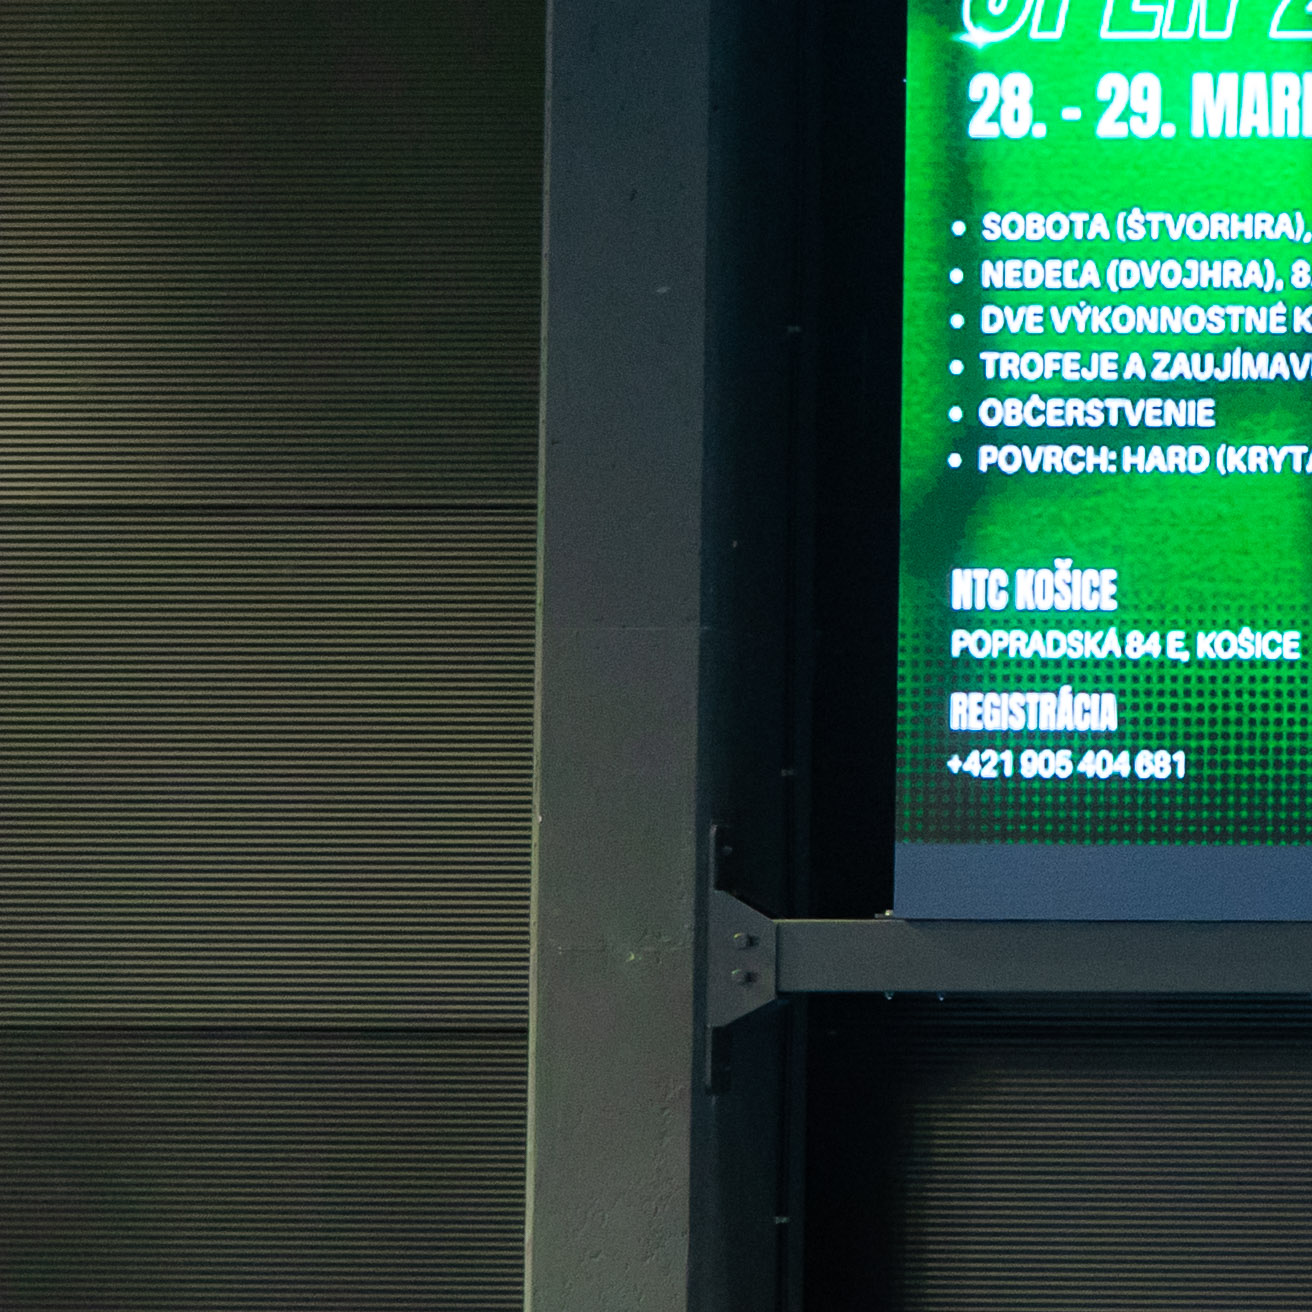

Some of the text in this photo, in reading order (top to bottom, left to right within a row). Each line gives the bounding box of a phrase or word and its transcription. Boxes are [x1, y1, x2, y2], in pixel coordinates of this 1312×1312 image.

[968, 72, 1047, 139] 28.
[1096, 72, 1176, 139] 29.
[982, 211, 1111, 241] SOBOTA
[1116, 206, 1312, 244] (ŠTVORHRA),
[1106, 258, 1284, 293] (DVOJHRA),
[981, 305, 1044, 334] DVE
[1050, 300, 1287, 335] VÝKONNOSTNÉ
[979, 350, 1119, 382] TROFEJE
[1123, 351, 1146, 380] A
[978, 394, 1216, 428] OBČERSTVENIE
[979, 444, 1117, 475] POVRCH:
[1122, 444, 1210, 474] HARD
[951, 557, 1118, 612] NTC KOŠICE
[951, 626, 1301, 662] POPRADSKÁ 84 E, KOŠICE
[949, 684, 1118, 732] REGISTRÁCIA
[946, 749, 1185, 779] +421 905 404 681
